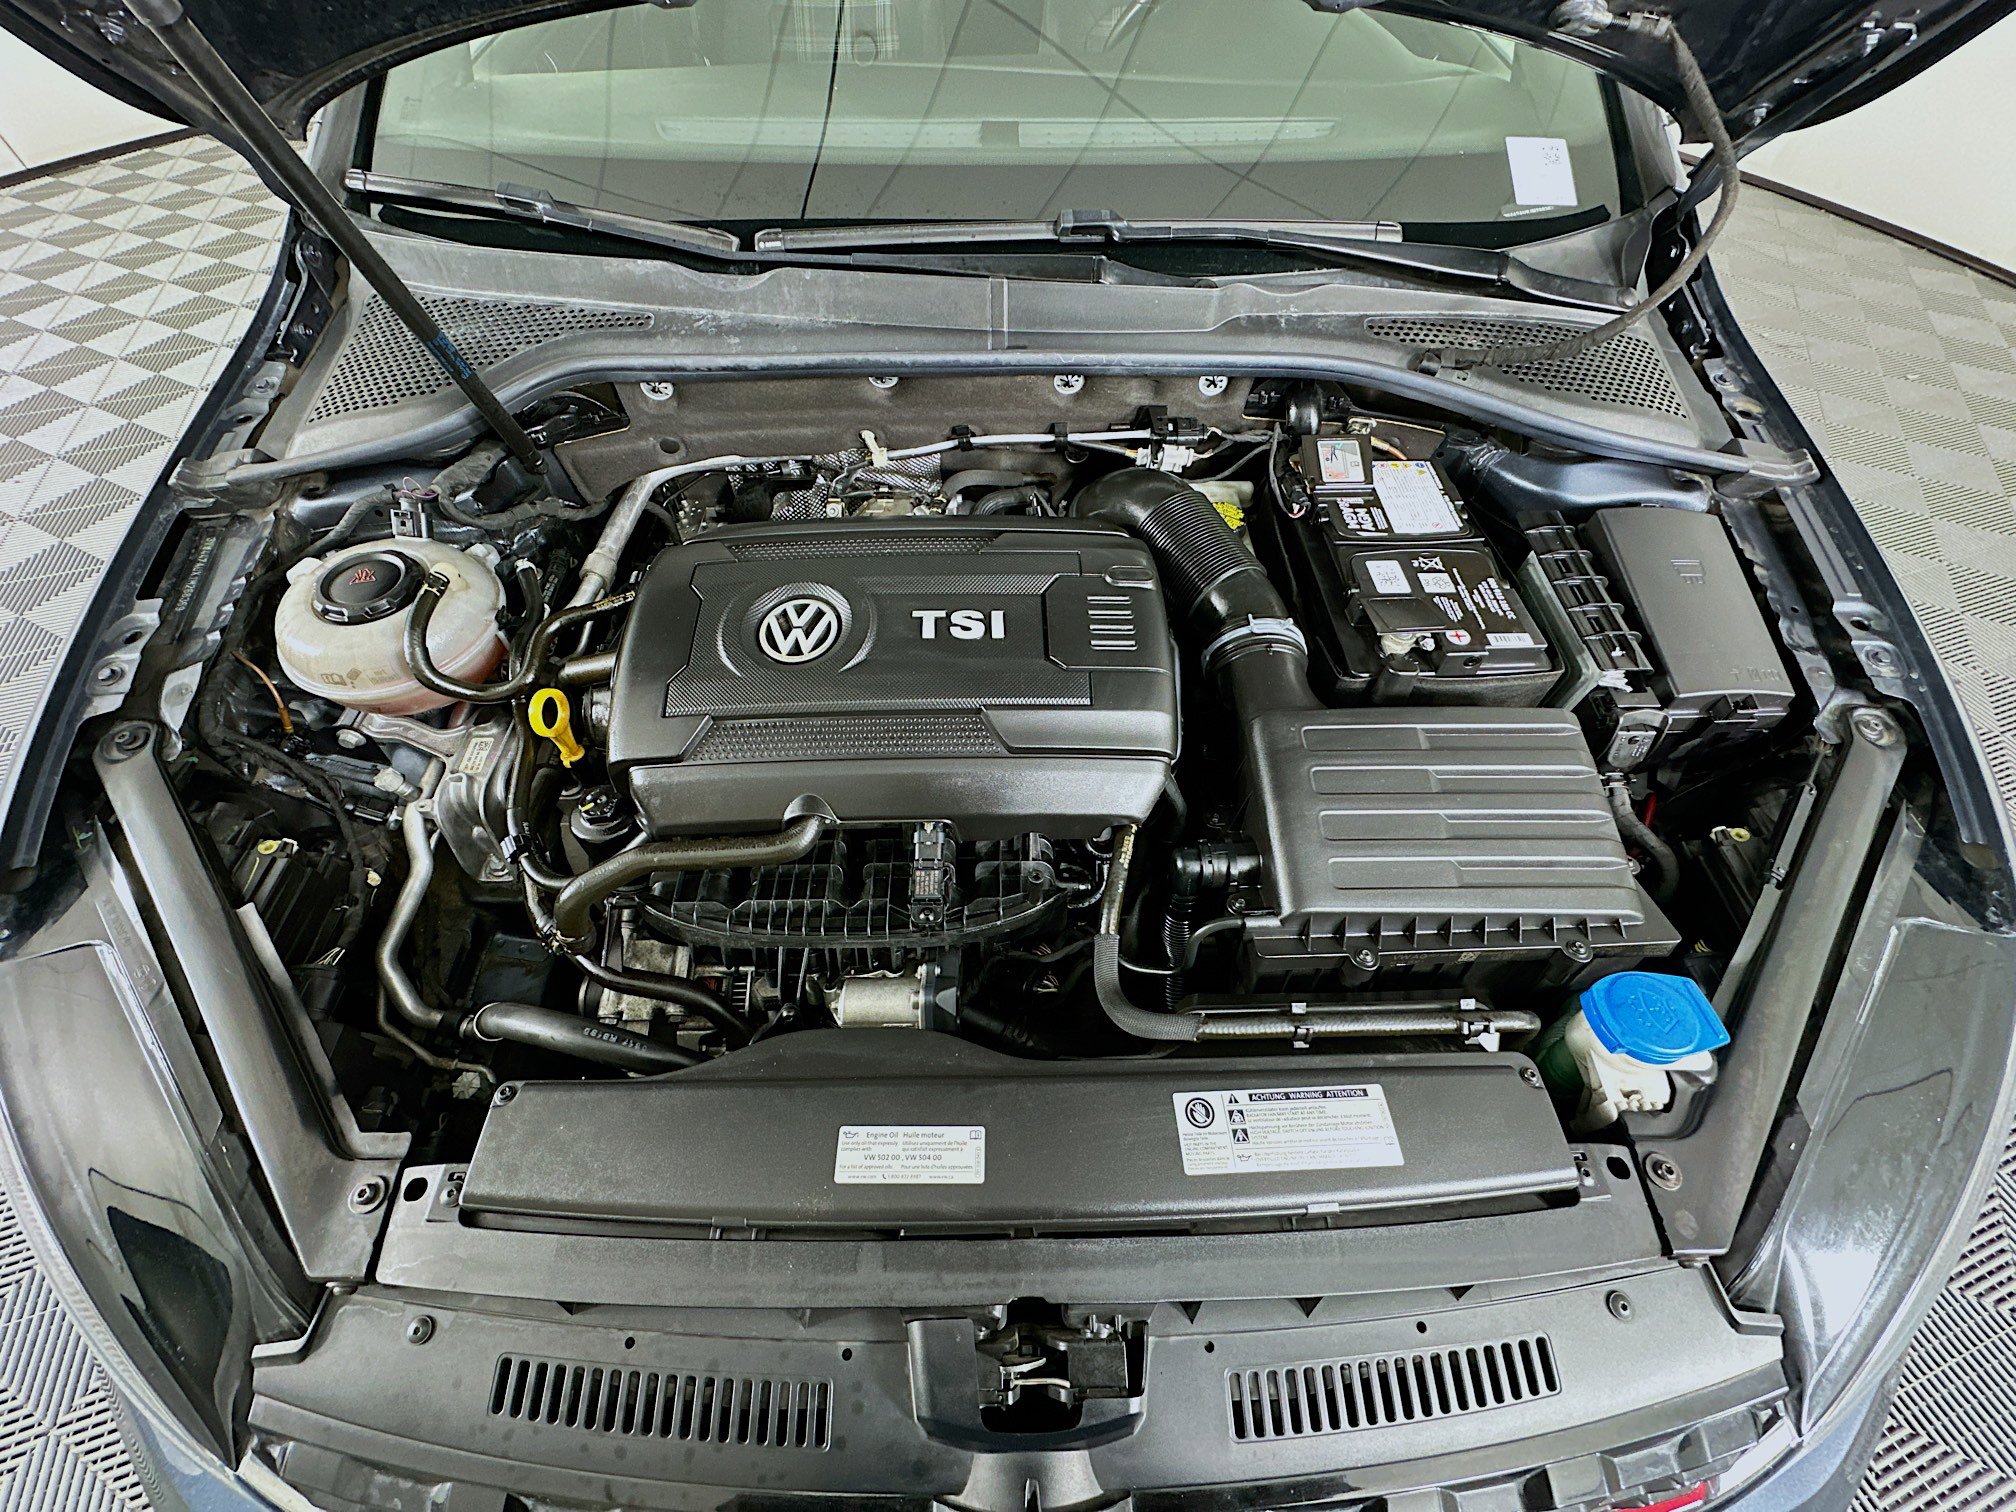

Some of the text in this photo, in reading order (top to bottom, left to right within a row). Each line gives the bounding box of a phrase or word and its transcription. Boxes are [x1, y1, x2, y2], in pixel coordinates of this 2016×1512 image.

[759, 599, 838, 663] VW
[911, 610, 1005, 640] TSI
[1251, 1089, 1364, 1101] ACHTUNG WARNING ATTENTION
[866, 1131, 899, 1140] Engine Oil
[903, 1131, 920, 1139] Huile
